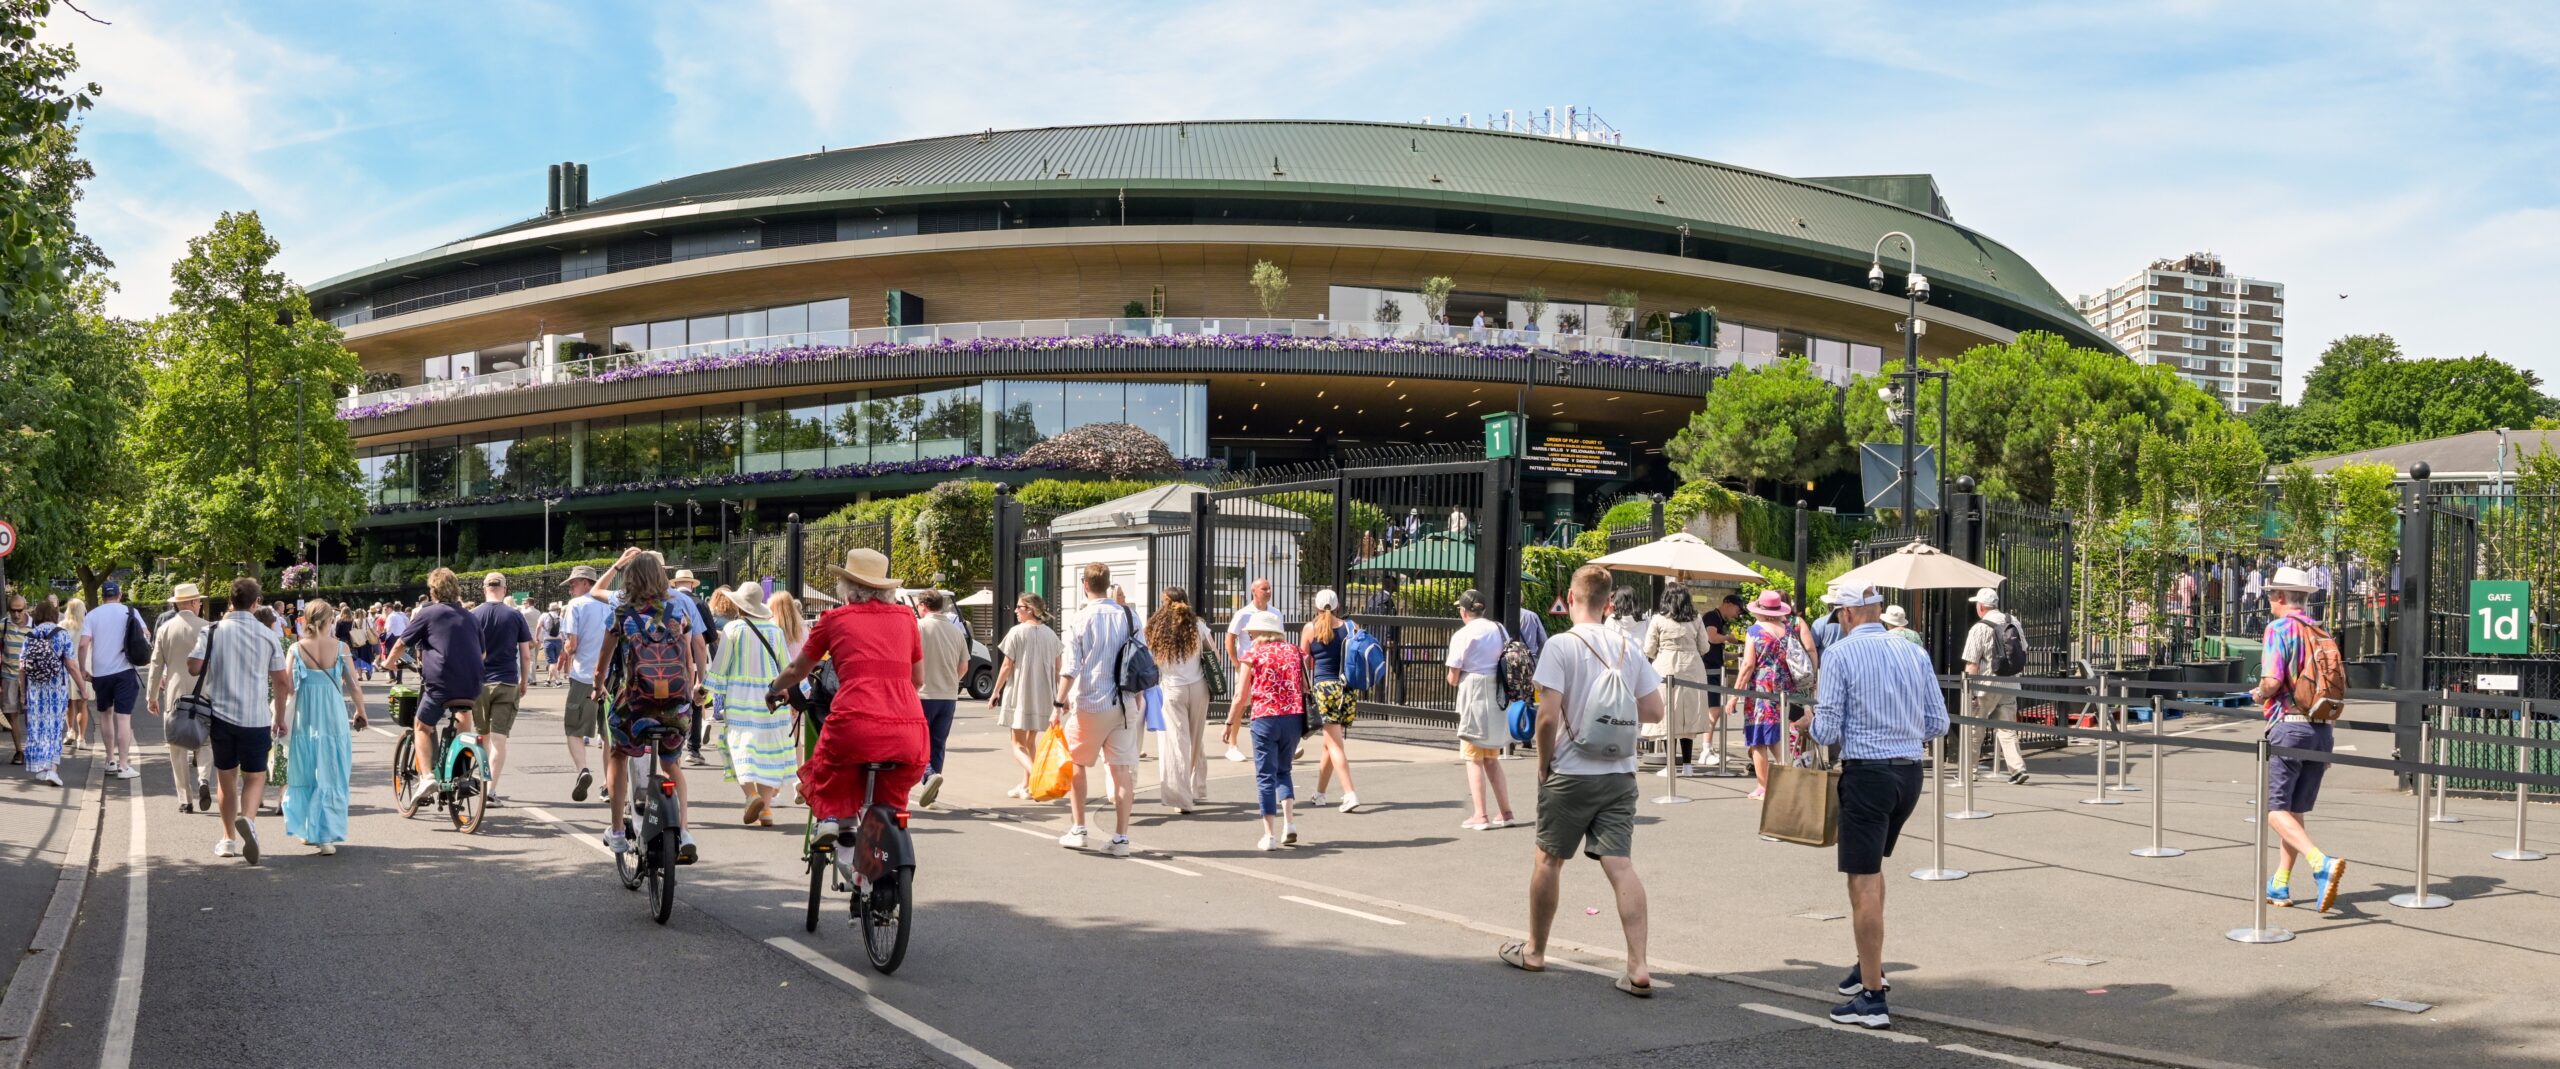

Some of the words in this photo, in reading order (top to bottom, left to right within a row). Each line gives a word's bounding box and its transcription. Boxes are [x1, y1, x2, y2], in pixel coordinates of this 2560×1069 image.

[1494, 431, 1500, 450] 1
[0, 531, 11, 546] 0
[1030, 575, 1036, 593] 1
[2487, 593, 2512, 602] GATE
[2478, 607, 2519, 640] 1d
[1610, 718, 1637, 726] Babola
